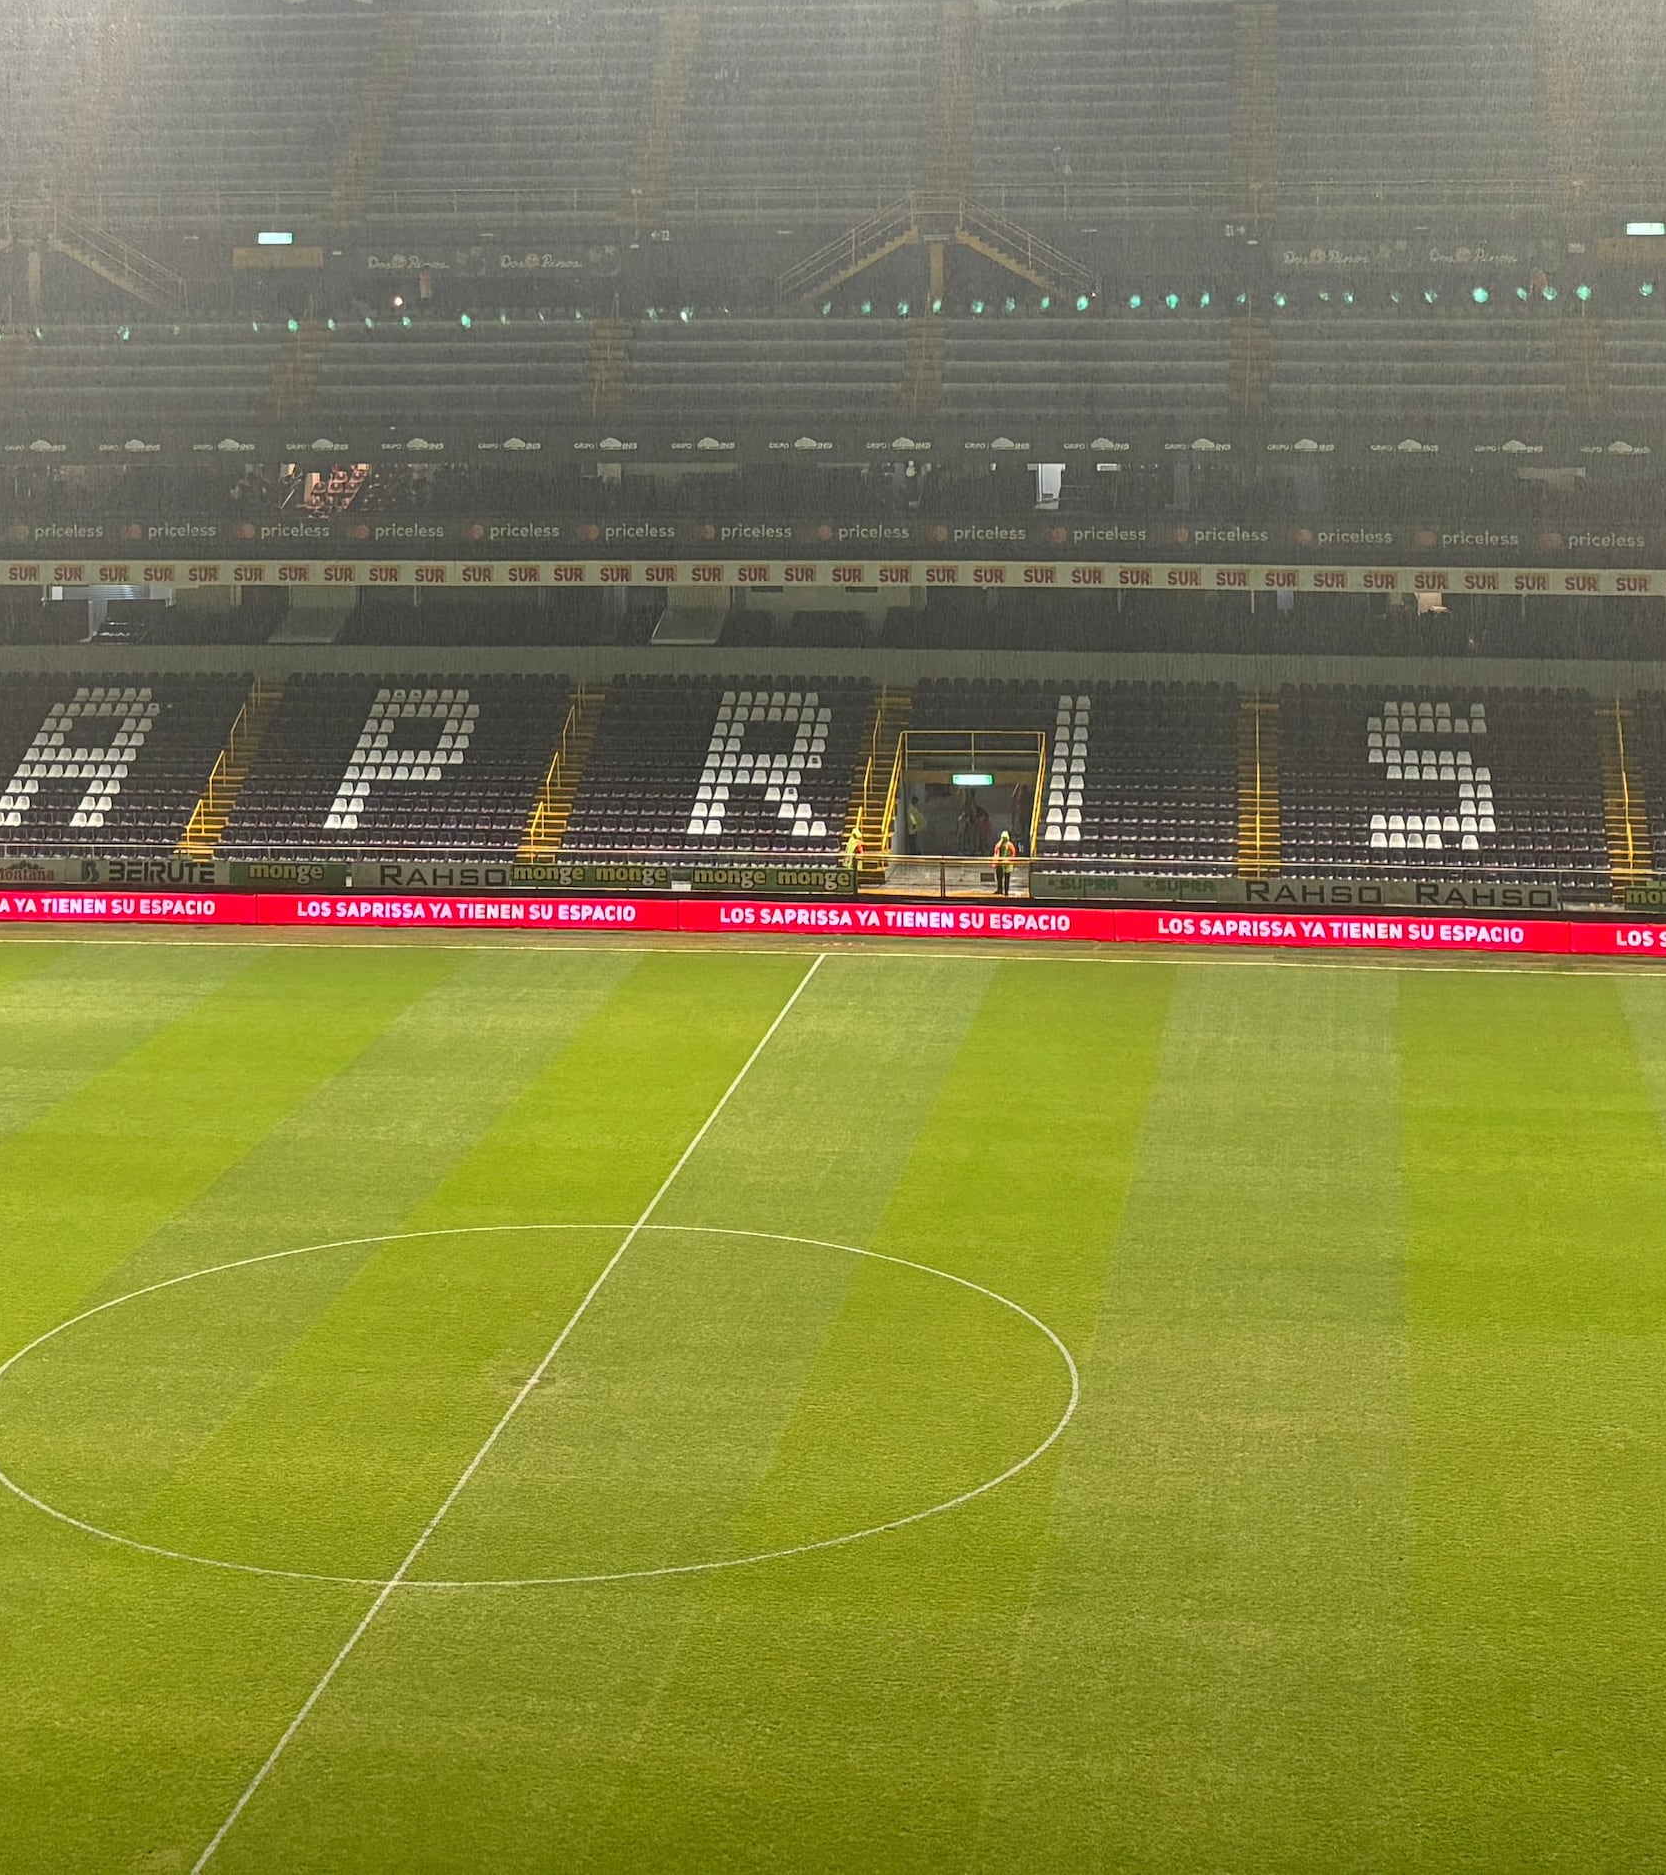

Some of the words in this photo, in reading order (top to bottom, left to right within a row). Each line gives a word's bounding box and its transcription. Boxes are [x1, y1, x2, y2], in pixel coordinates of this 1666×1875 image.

[147, 522, 217, 540] priceless
[259, 522, 330, 540] priceless
[488, 523, 560, 541] priceless
[602, 523, 675, 541] priceless
[836, 523, 910, 541] priceless
[952, 525, 1026, 542] priceless
[1193, 526, 1269, 544] priceless
[1442, 529, 1519, 547] priceless
[8, 565, 39, 581] SUR
[188, 565, 219, 582] SUR
[323, 565, 354, 582] SUR
[462, 566, 492, 583] SUR
[600, 566, 632, 583] SUR
[737, 565, 768, 582] SUR
[879, 566, 911, 583] SUR
[1071, 567, 1103, 584] SUR
[1216, 569, 1249, 587] SUR
[1414, 571, 1449, 590] SUR
[1615, 575, 1649, 592] SUR
[108, 860, 215, 885] BEIRUTE
[249, 863, 323, 885] monge
[379, 864, 508, 886] RAHSO
[513, 864, 585, 886] monge
[595, 865, 668, 887] monge
[693, 867, 767, 889] monge
[776, 869, 851, 892] monge
[1245, 880, 1382, 904] RAHSO
[1414, 882, 1553, 909] RAHSO
[14, 898, 37, 913] YA
[41, 898, 107, 914] TIENEN
[111, 898, 135, 914] SU
[139, 899, 216, 915] ESPACIO
[297, 901, 332, 917] LOS
[336, 902, 425, 919] SAPRISSA
[429, 903, 453, 919] YA
[456, 903, 524, 920] TIENEN
[529, 904, 553, 920] SU
[558, 904, 636, 922] ESPACIO
[720, 907, 755, 924] LOS
[760, 908, 853, 926] SAPRISSA
[856, 910, 880, 926] YA
[884, 911, 954, 928] TIENEN
[959, 912, 985, 929] SU
[989, 913, 1070, 932] ESPACIO
[1158, 918, 1195, 935] LOS
[1199, 919, 1296, 937] SAPRISSA
[1300, 921, 1326, 938] YA
[1329, 922, 1403, 939] TIENEN
[1408, 924, 1434, 941] SU
[1439, 924, 1524, 944] ESPACIO
[1616, 930, 1654, 947] LOS
